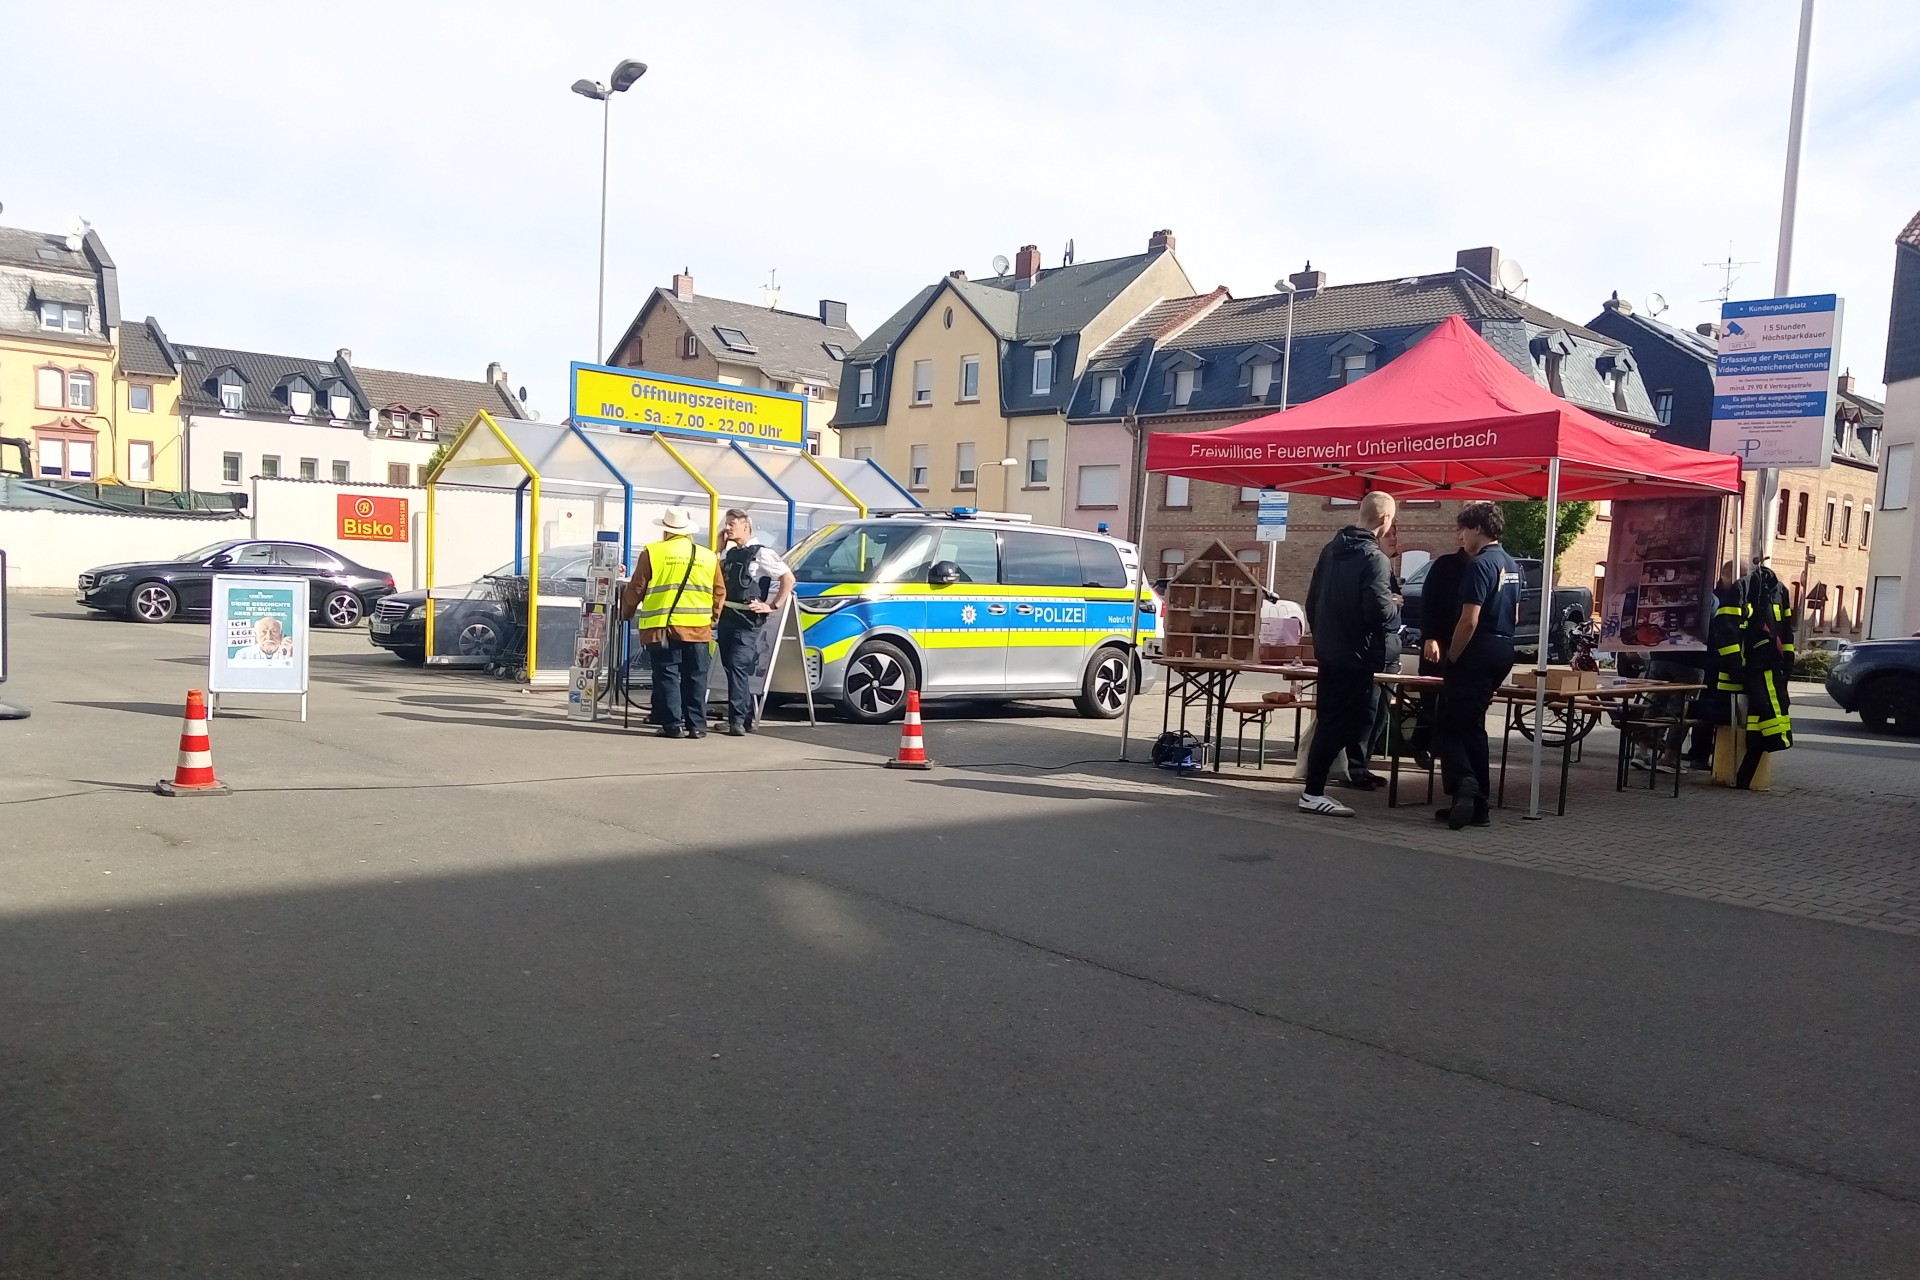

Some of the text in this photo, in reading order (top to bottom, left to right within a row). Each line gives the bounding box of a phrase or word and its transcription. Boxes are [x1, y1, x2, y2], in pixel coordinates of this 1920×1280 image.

[1749, 302, 1807, 313] Kundenparkplatz
[1775, 323, 1806, 331] Stunden
[1720, 352, 1827, 364] Erfassung der Parkdauer per
[1718, 362, 1828, 374] Video-Kennzeichenerkennung
[1769, 382, 1812, 390] Vertragsstrafe
[631, 380, 758, 415] Öffnungszeiten:
[601, 402, 628, 420] Mo.
[675, 412, 705, 428] 7.00
[718, 418, 755, 435] 22.00
[759, 424, 783, 438] Uhr
[1190, 429, 1497, 460] Freiwillige Feuerwehr Unterliederbach
[344, 518, 394, 536] Bisko
[1034, 607, 1085, 623] POLIZEI
[1108, 616, 1125, 624] Notruf
